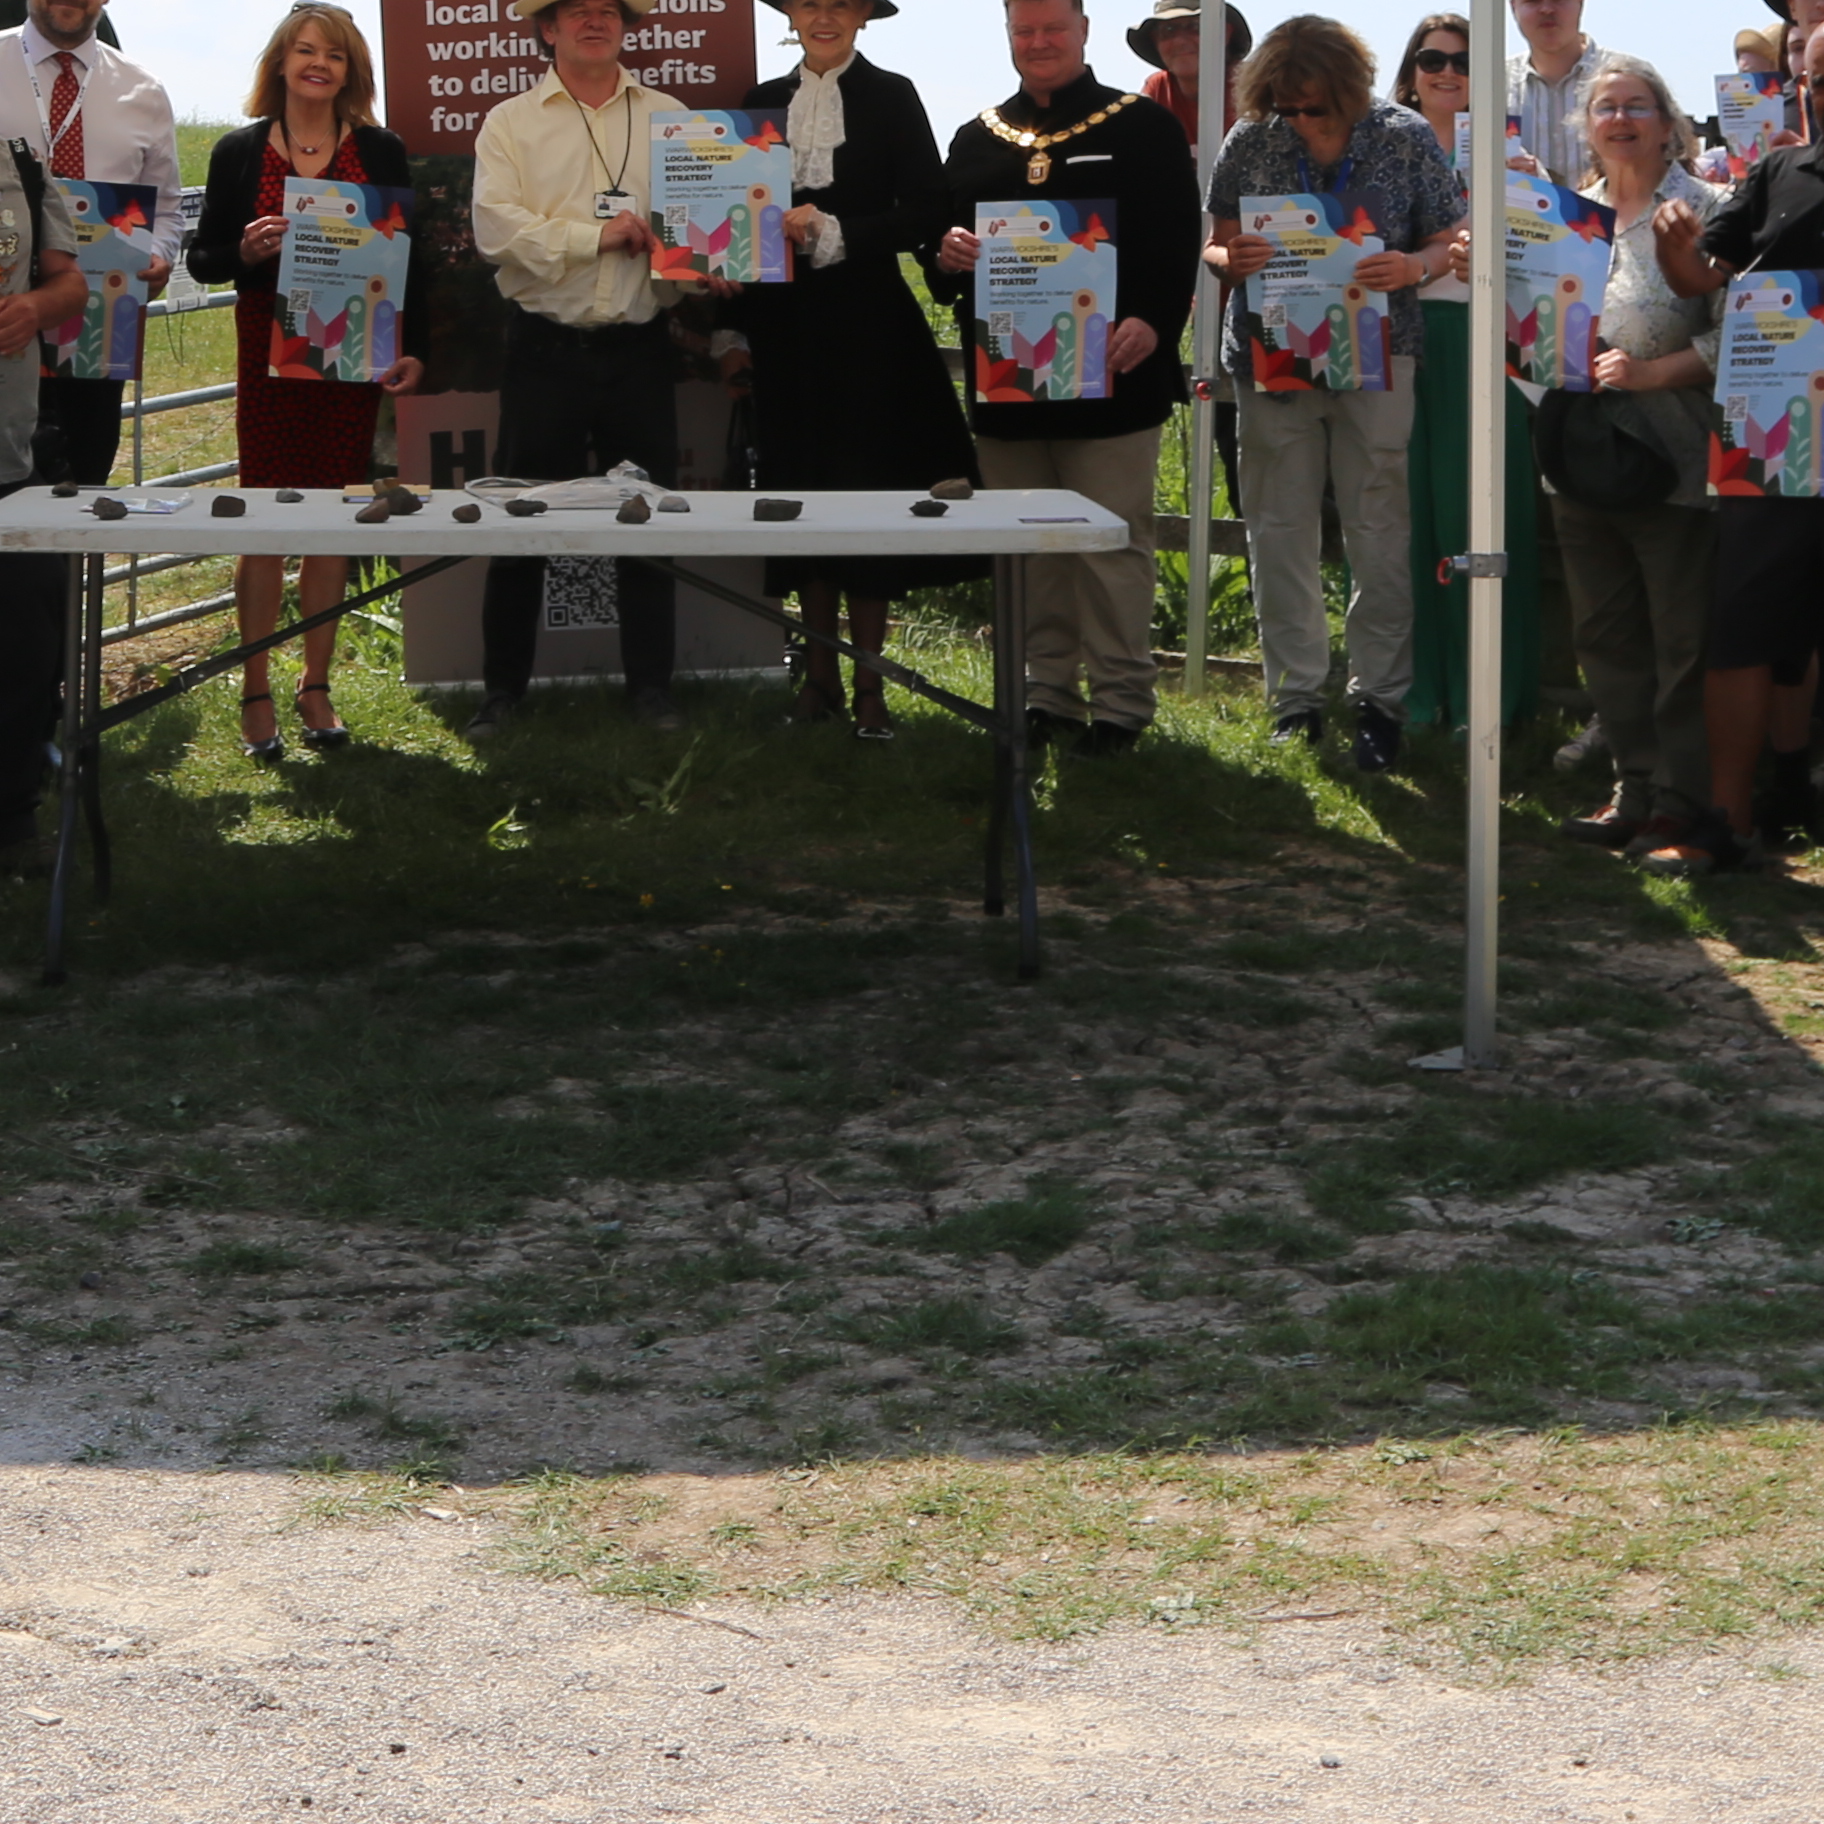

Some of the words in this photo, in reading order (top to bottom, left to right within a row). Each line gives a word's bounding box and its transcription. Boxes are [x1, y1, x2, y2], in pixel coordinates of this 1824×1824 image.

[621, 24, 706, 51] ether
[428, 75, 463, 96] to
[470, 67, 545, 95] deliv
[430, 107, 479, 132] for
[665, 174, 714, 182] STRATEGY
[1511, 228, 1550, 241] NATURE
[295, 234, 323, 243] LOCAL
[325, 236, 360, 246] NATURE
[295, 244, 341, 255] RECOVERY
[294, 255, 340, 266] STRATEGY
[990, 256, 1019, 264] LOCAL
[1021, 255, 1058, 263] NATURE
[989, 267, 1038, 275] RECOVERY
[990, 278, 1038, 286] STRATEGY
[1733, 333, 1760, 342] LOCAL
[1731, 345, 1776, 354] RECOVERY
[1730, 357, 1775, 366] STRATEGY
